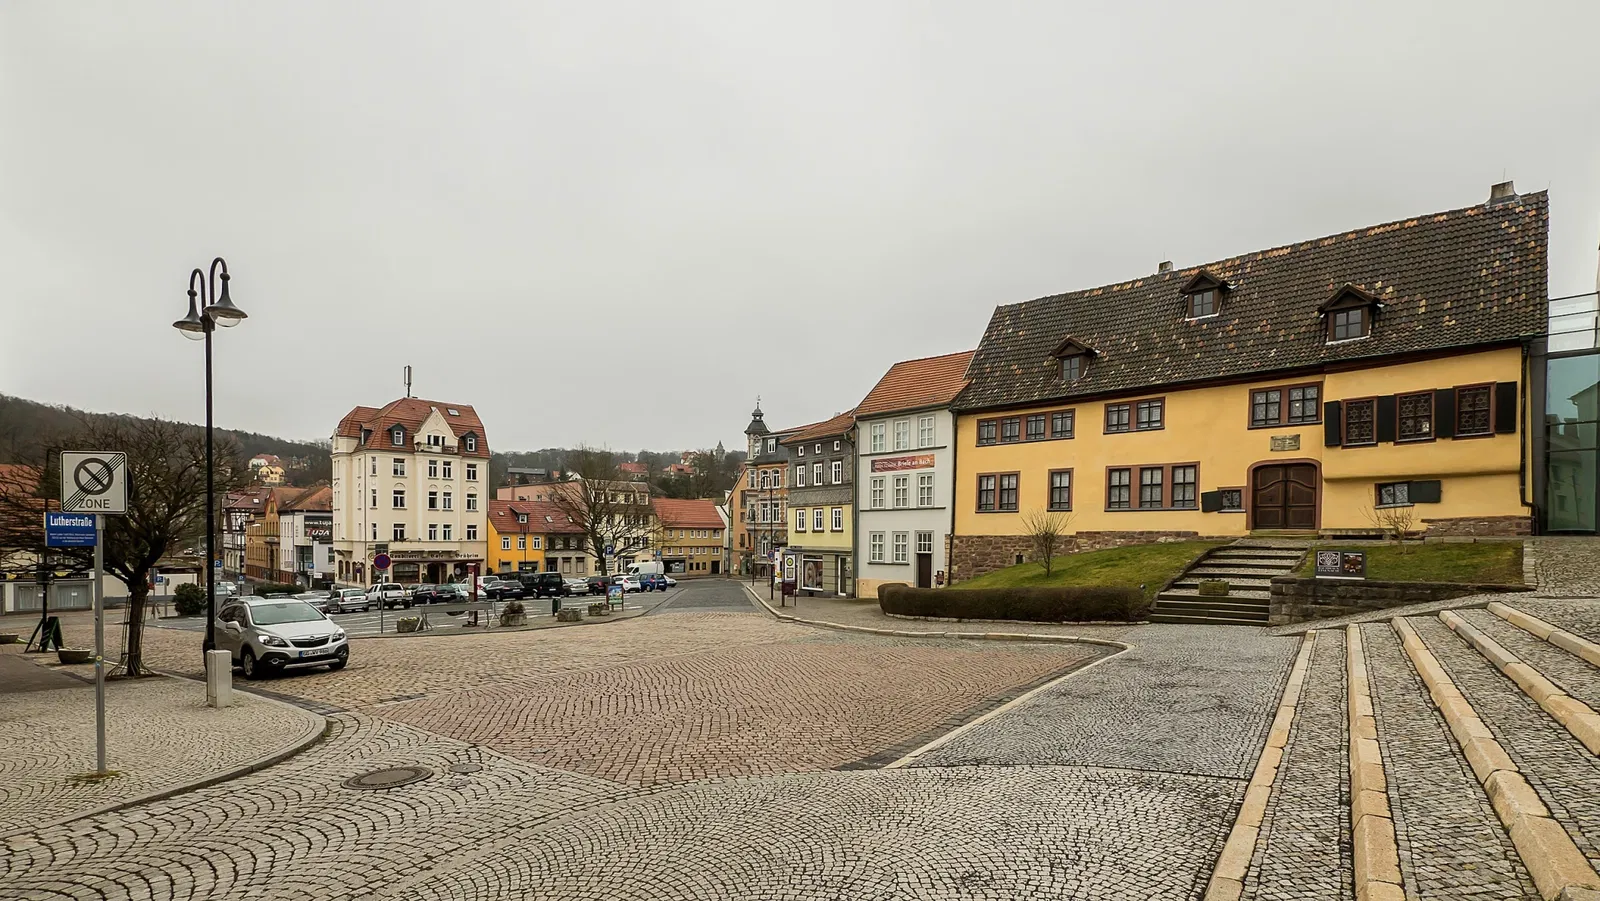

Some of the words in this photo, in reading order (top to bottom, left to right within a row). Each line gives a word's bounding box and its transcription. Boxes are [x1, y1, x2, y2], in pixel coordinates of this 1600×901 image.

[78, 498, 110, 509] ZONE
[50, 516, 92, 526] Lutherstraße
[306, 528, 330, 536] TUJA
